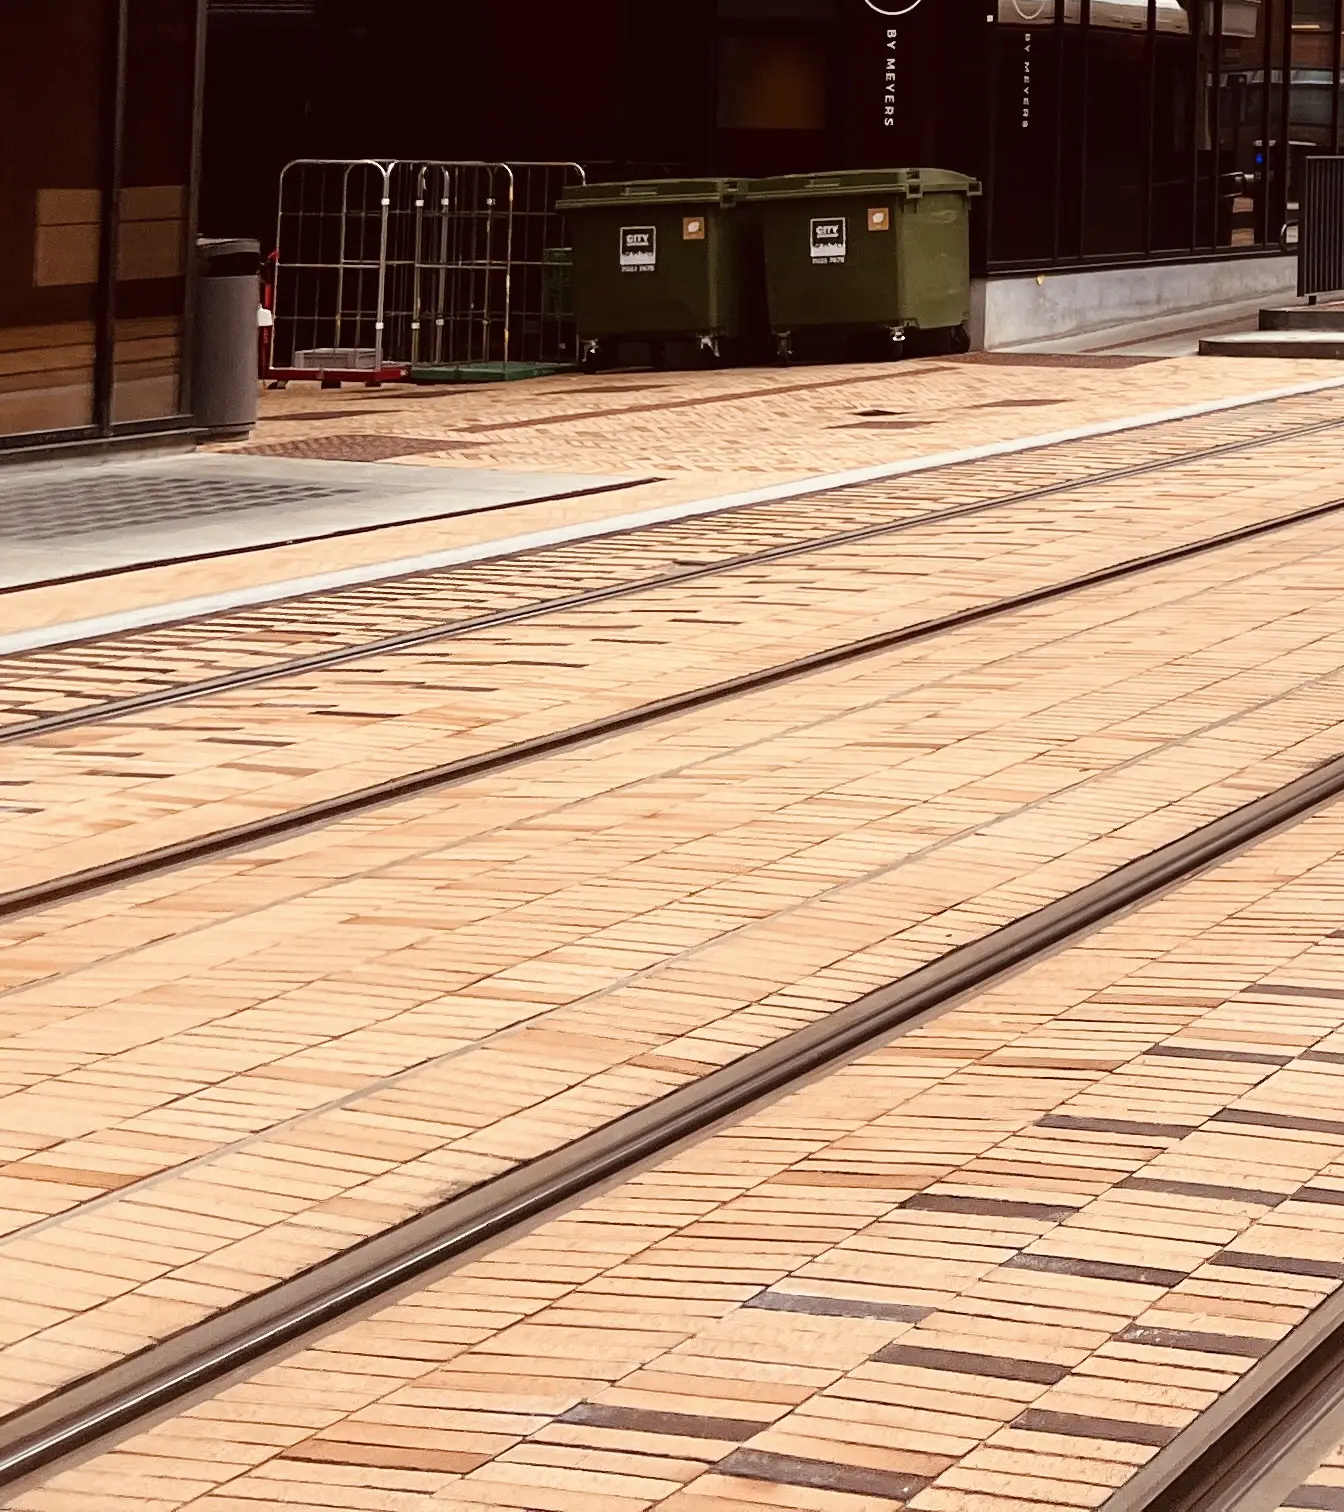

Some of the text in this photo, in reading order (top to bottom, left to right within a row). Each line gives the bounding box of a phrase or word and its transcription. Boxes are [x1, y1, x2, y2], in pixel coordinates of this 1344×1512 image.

[884, 29, 897, 126] BY MEYERS
[1022, 62, 1030, 128] MEYERS
